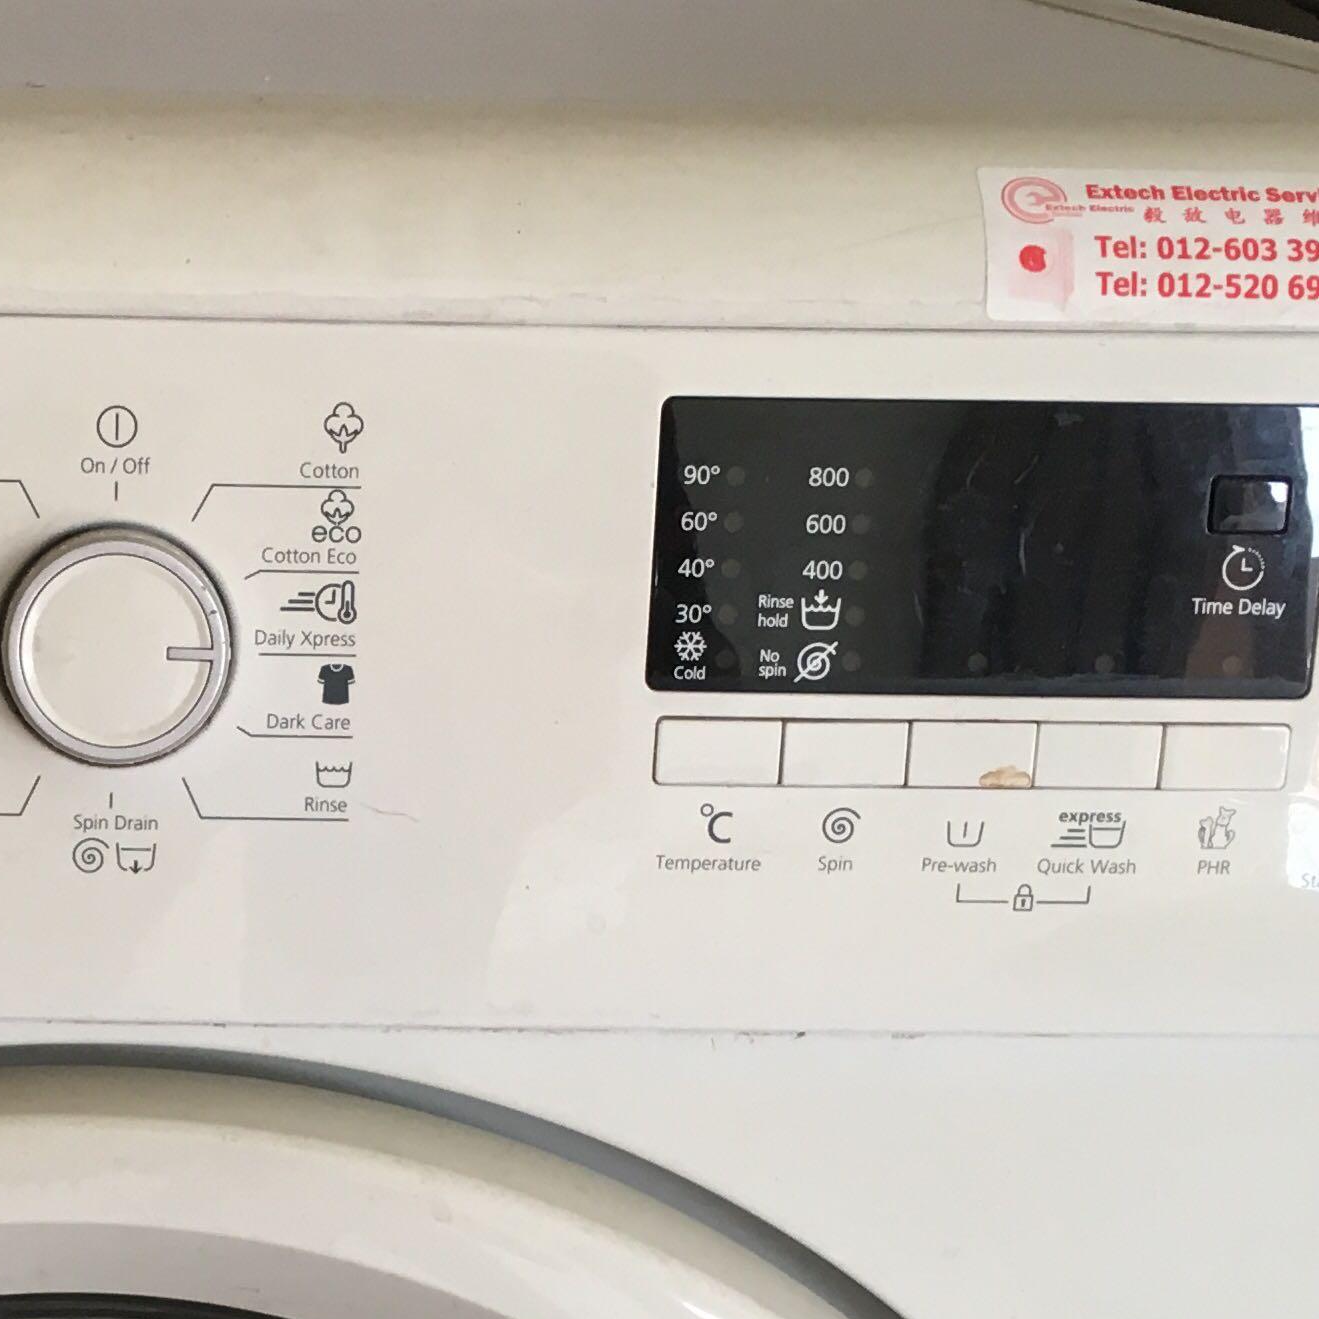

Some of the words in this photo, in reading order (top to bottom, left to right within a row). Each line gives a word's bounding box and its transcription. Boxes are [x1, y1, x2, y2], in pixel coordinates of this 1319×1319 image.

[1085, 184, 1165, 201] Extech
[1171, 185, 1260, 202] Electric
[1095, 236, 1147, 259] Tel:
[1157, 236, 1278, 262] 012-603
[1287, 239, 1319, 263] 39
[1096, 271, 1147, 297] Tel:
[1158, 272, 1279, 300] 012-520
[1288, 275, 1319, 301] 69
[80, 457, 106, 474] On
[122, 457, 151, 474] Off
[299, 461, 360, 480] Cotton
[683, 464, 721, 485] 90°
[808, 466, 850, 487] 800
[680, 511, 718, 532] 60°
[805, 513, 847, 535] 600
[311, 525, 362, 544] eco
[261, 546, 321, 564] Cotton
[326, 547, 357, 565] Eco
[677, 557, 715, 578] 40°
[802, 559, 843, 581] 400
[757, 594, 795, 610] Rinse
[1191, 596, 1234, 616] Time
[1238, 597, 1287, 620] Delay
[674, 603, 712, 624] 30°
[757, 612, 789, 629] hold
[254, 629, 295, 650] Daily
[300, 631, 357, 650] Xpress
[759, 648, 781, 664] No
[673, 665, 707, 681] Cold
[757, 663, 787, 679] spin
[266, 713, 306, 731] Dark
[311, 713, 351, 731] Care
[304, 797, 348, 813] Rinse
[73, 814, 109, 833] Spin
[114, 815, 159, 831] Drain
[1058, 808, 1122, 826] express
[655, 854, 762, 873] Temperature
[817, 856, 854, 872] Spin
[920, 857, 998, 875] Pre-wash
[1036, 857, 1084, 876] Quick
[1089, 859, 1137, 876] Wash
[1196, 859, 1232, 876] PHR
[1301, 872, 1319, 889] St
